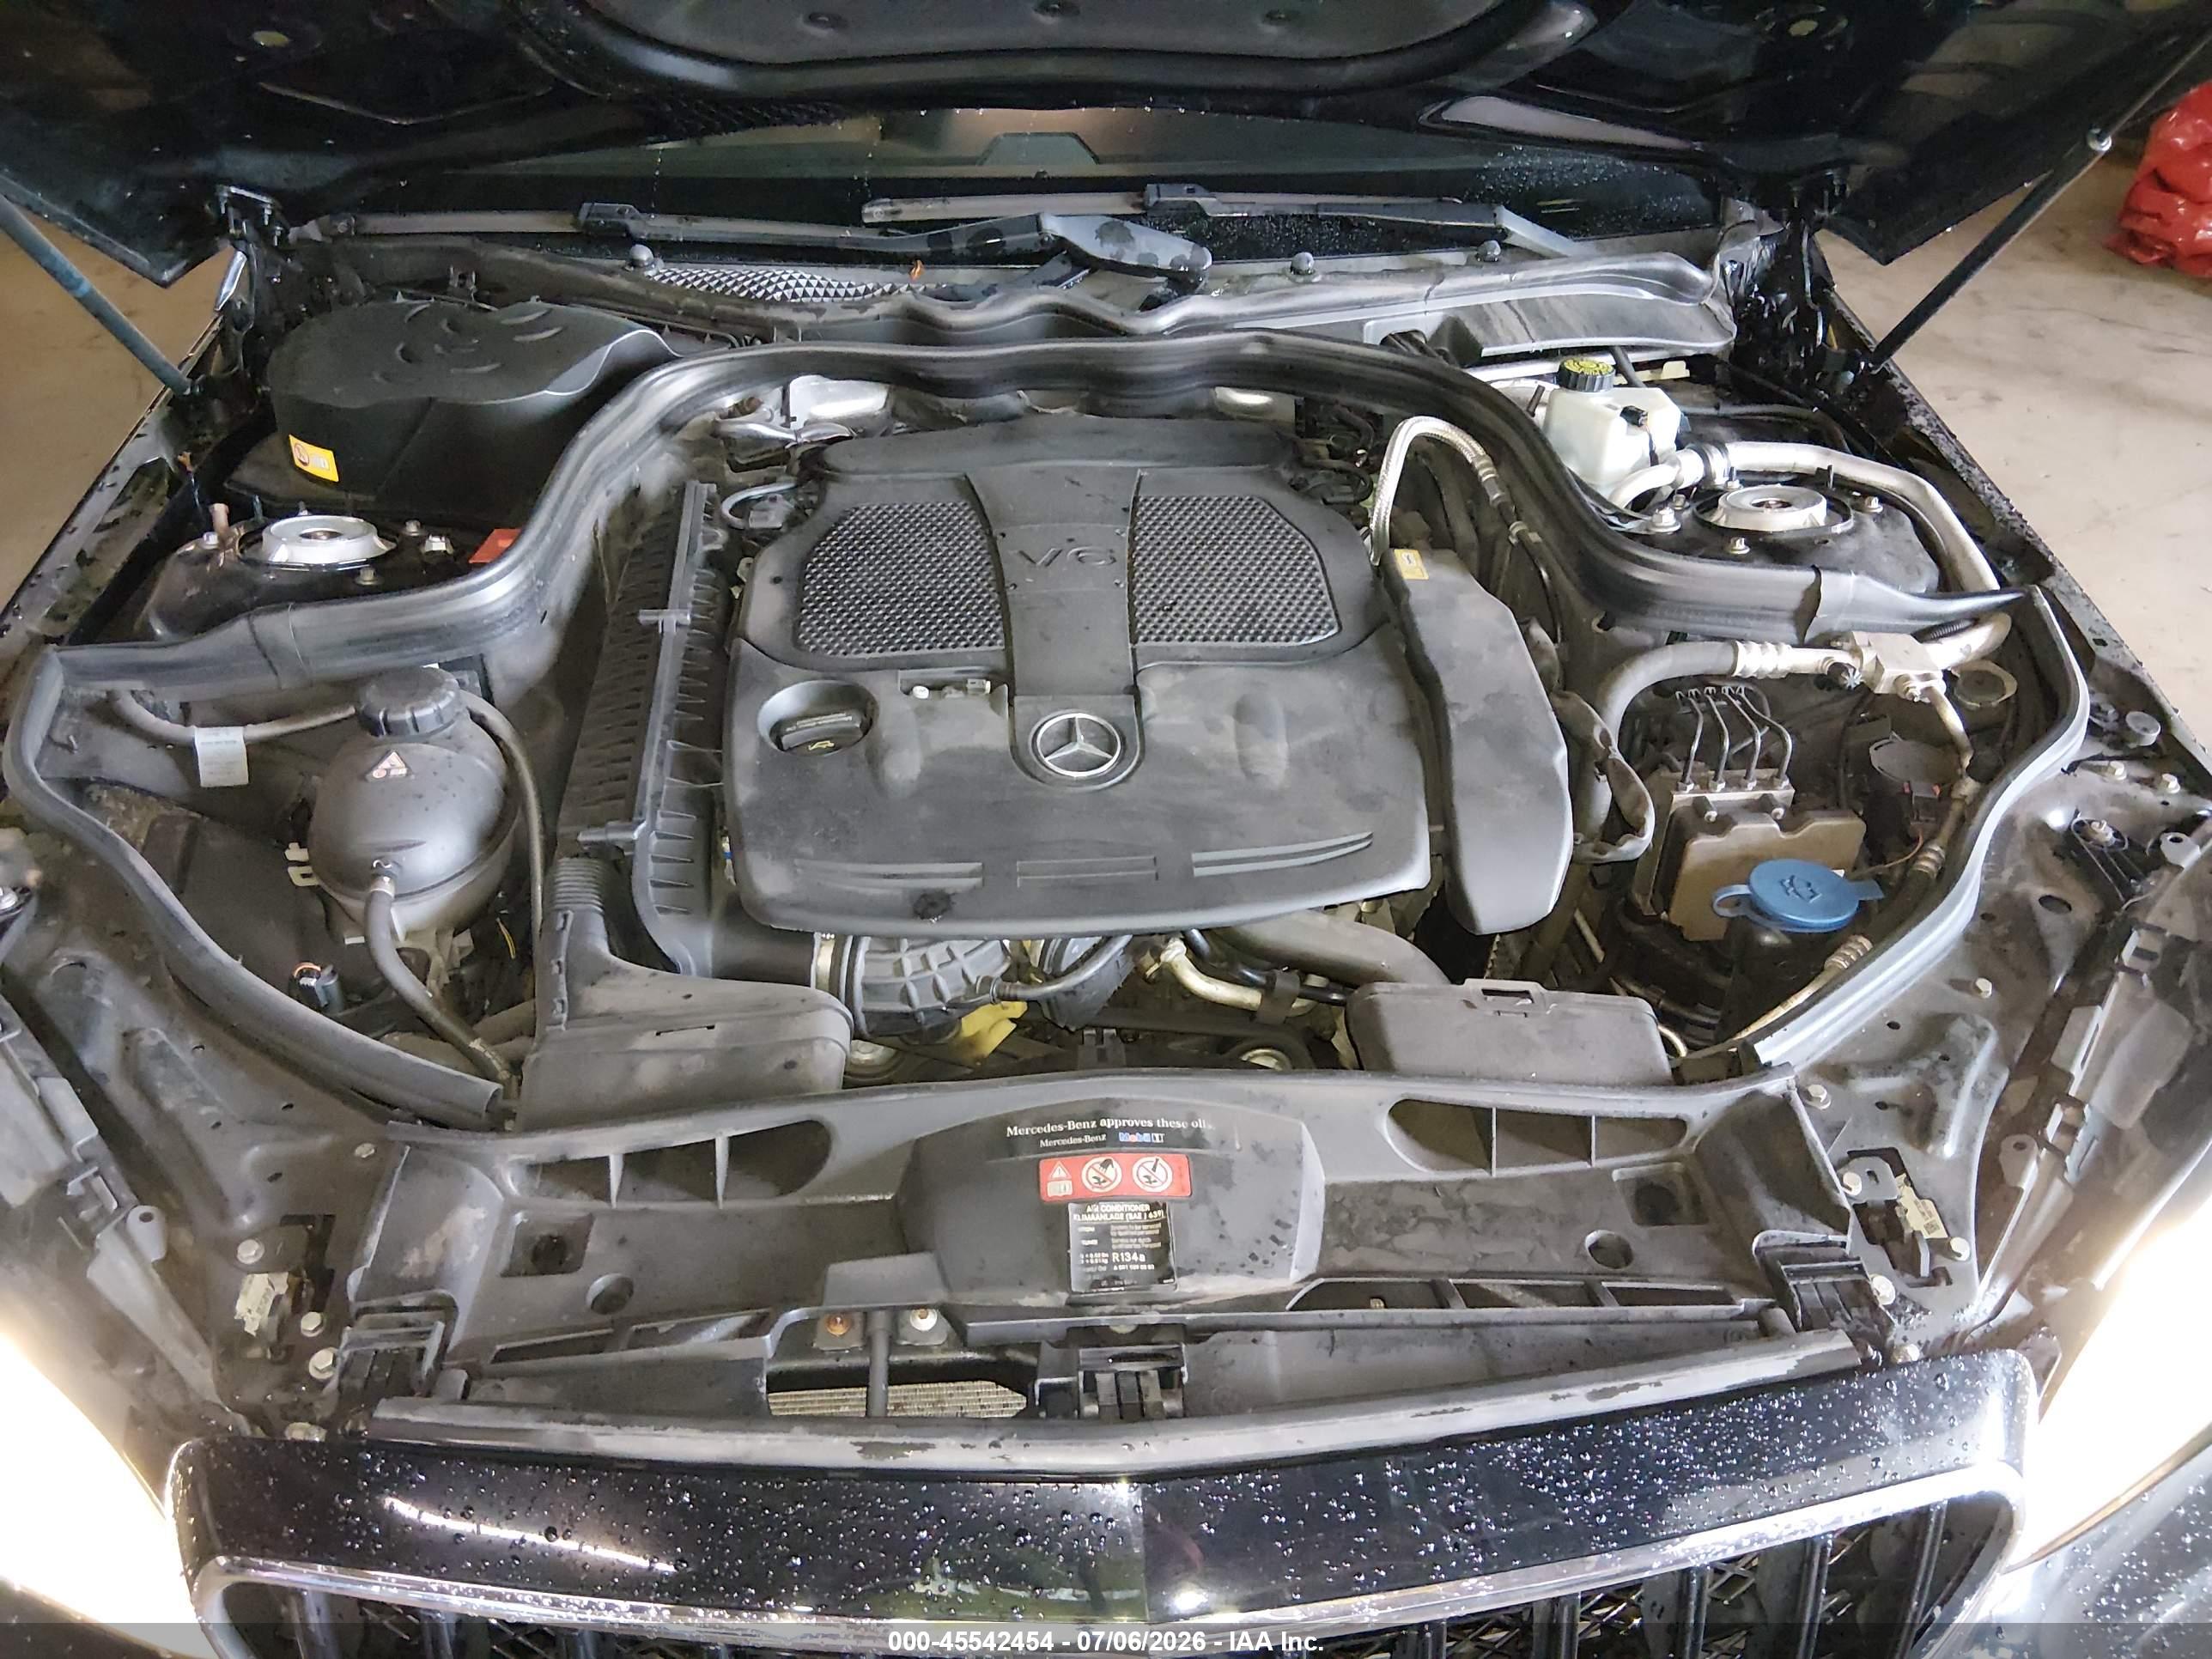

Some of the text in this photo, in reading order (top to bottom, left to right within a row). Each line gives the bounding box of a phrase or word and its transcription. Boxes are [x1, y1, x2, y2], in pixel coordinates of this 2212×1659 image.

[1006, 1119, 1098, 1138] Mercedes-Benz
[1100, 1118, 1154, 1129] approves
[1156, 1117, 1189, 1129] these
[1039, 1133, 1107, 1148] Mercedes-Benz
[1100, 1203, 1152, 1212] CONDITIONER
[1111, 1251, 1146, 1262] R134a
